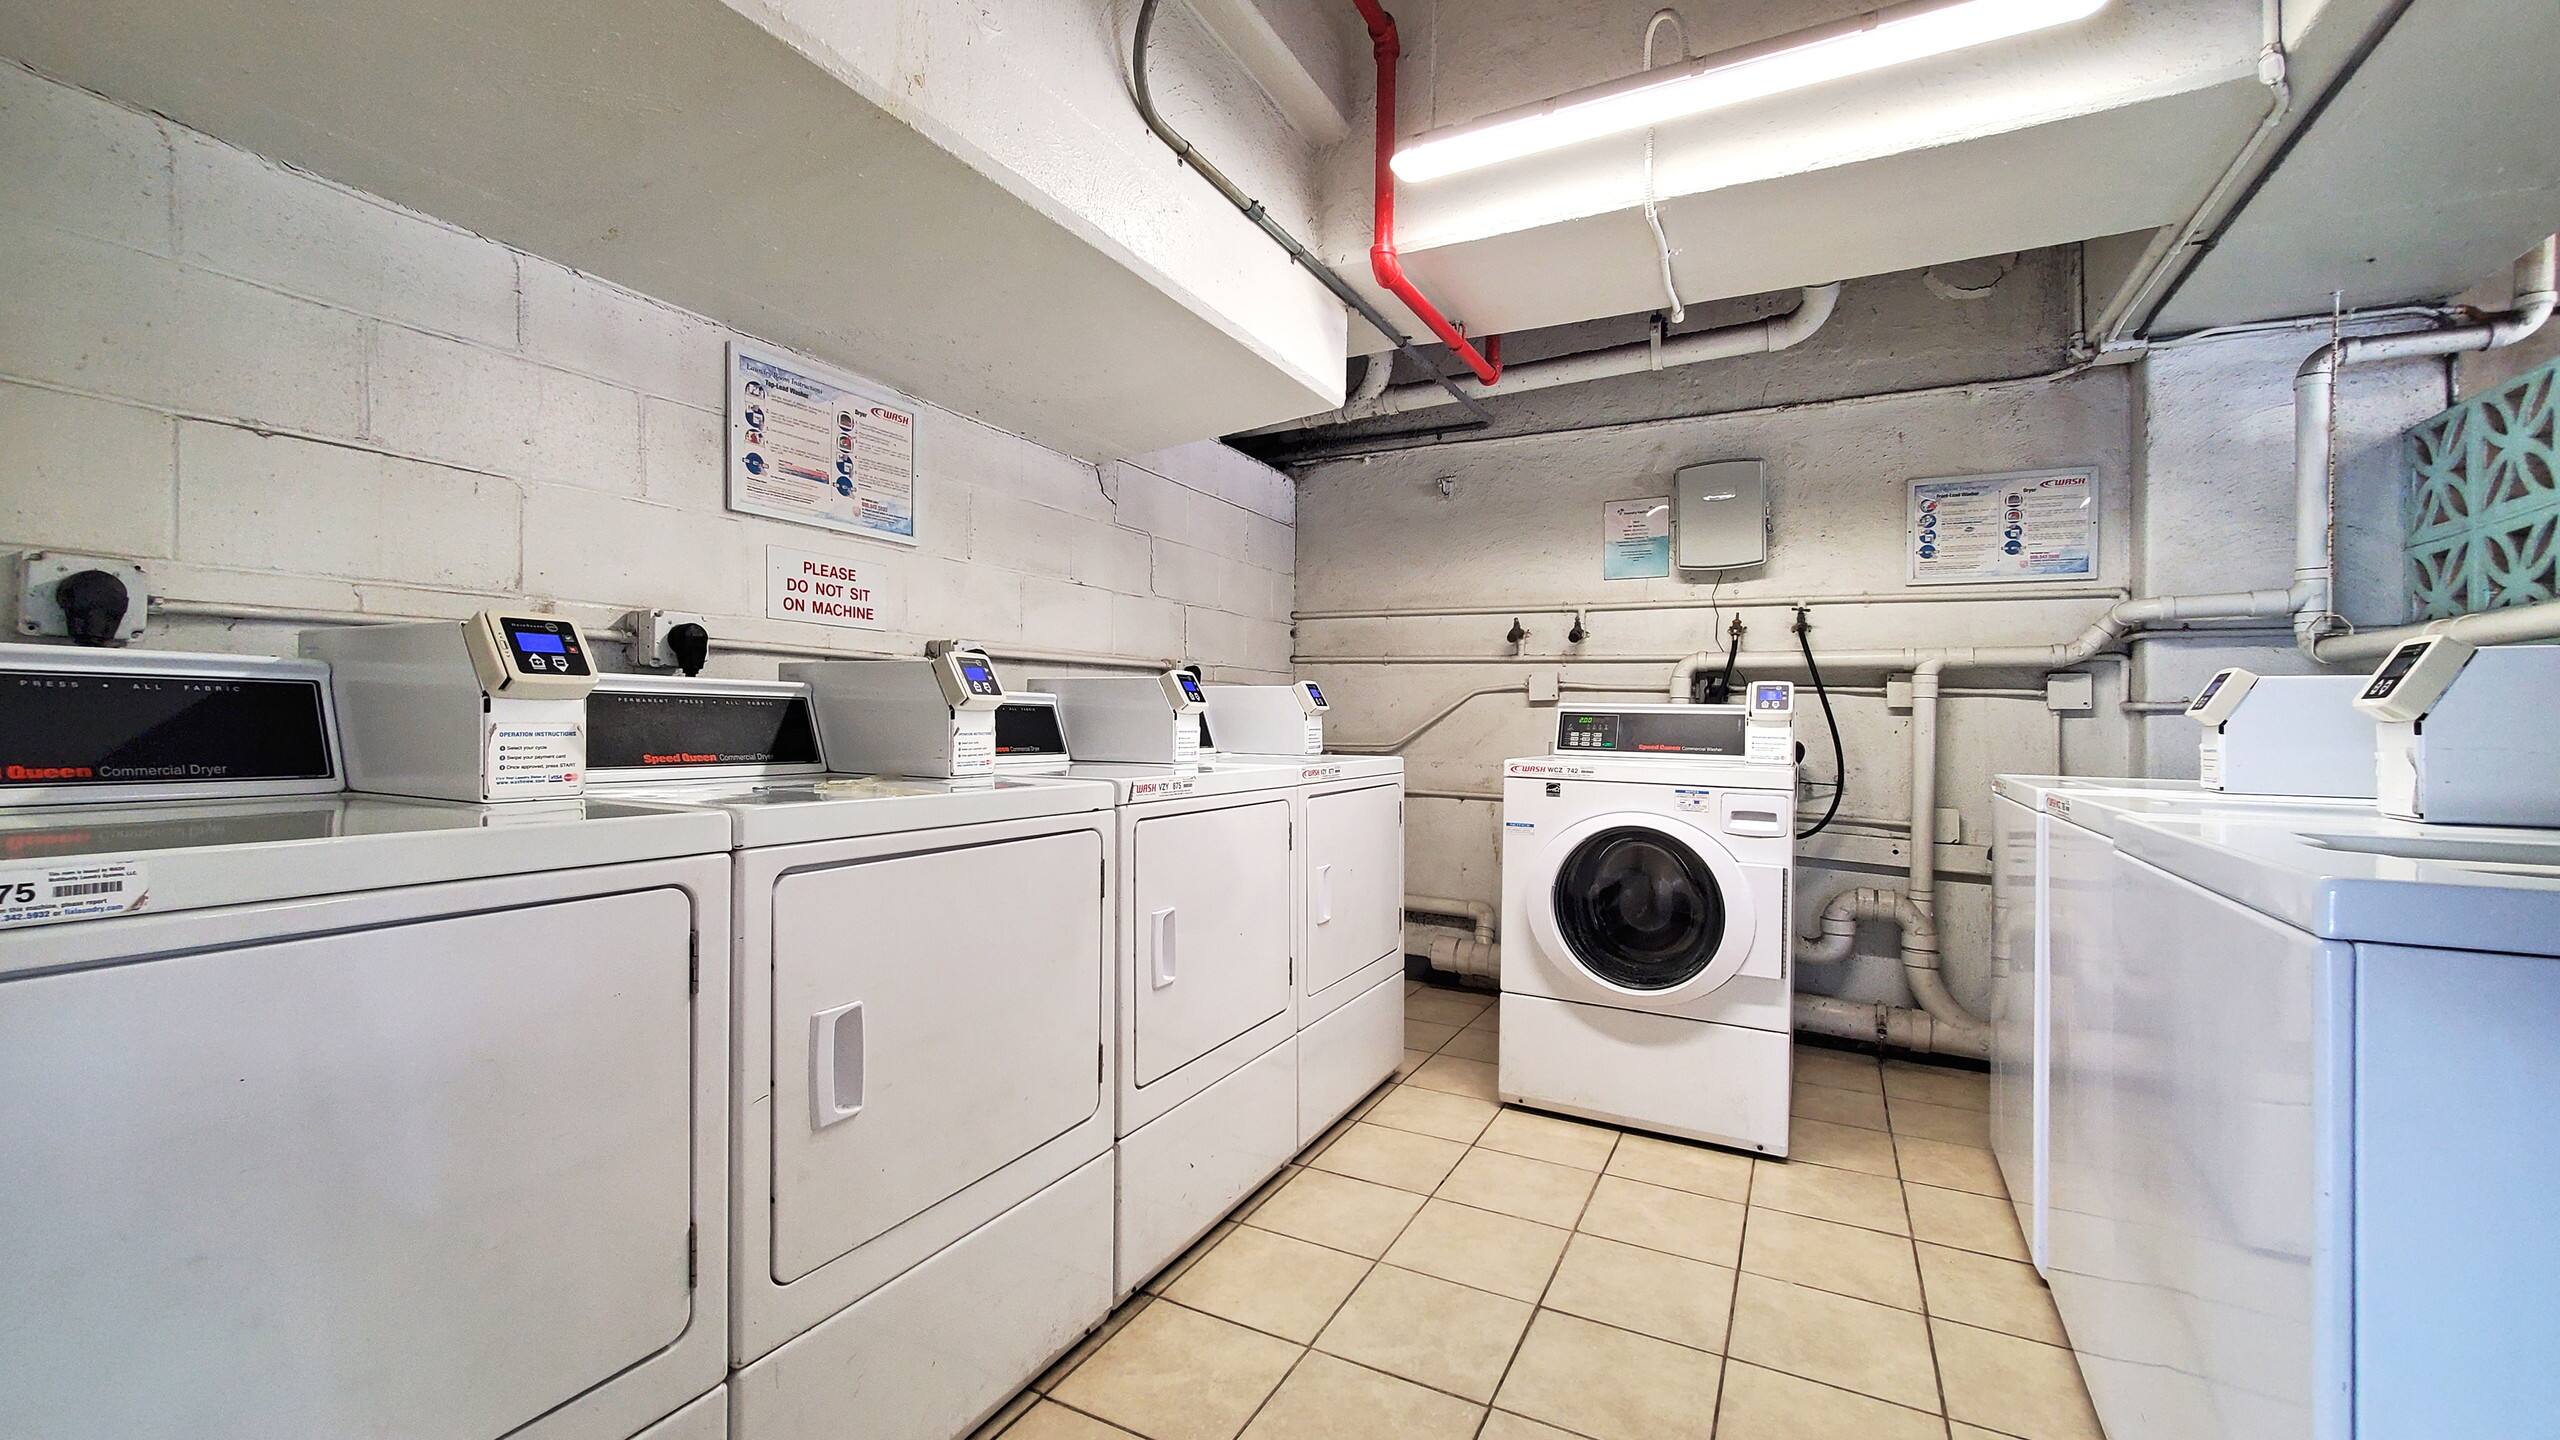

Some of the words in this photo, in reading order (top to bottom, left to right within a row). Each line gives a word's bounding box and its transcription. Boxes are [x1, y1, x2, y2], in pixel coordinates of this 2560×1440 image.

[765, 379, 789, 393] Top-Load
[790, 387, 809, 399] Washer
[854, 409, 868, 419] Dryer
[883, 411, 909, 425] WASH
[2054, 477, 2086, 486] WASH
[803, 561, 857, 582] PLEASE
[787, 578, 809, 593] DO
[815, 582, 844, 598] NOT
[850, 588, 871, 602] SIT
[783, 597, 805, 612] ON
[812, 600, 874, 620] MACHINE
[20, 679, 80, 688] PRESS
[534, 754, 555, 762] payment
[643, 753, 681, 764] Speed
[682, 752, 718, 763] Queen
[719, 753, 757, 761] Commercial
[7, 764, 93, 780] Queen
[100, 764, 186, 777] Commercial
[190, 764, 228, 777] Dryer
[1136, 784, 1157, 793] WASH
[1159, 782, 1170, 791] VZY
